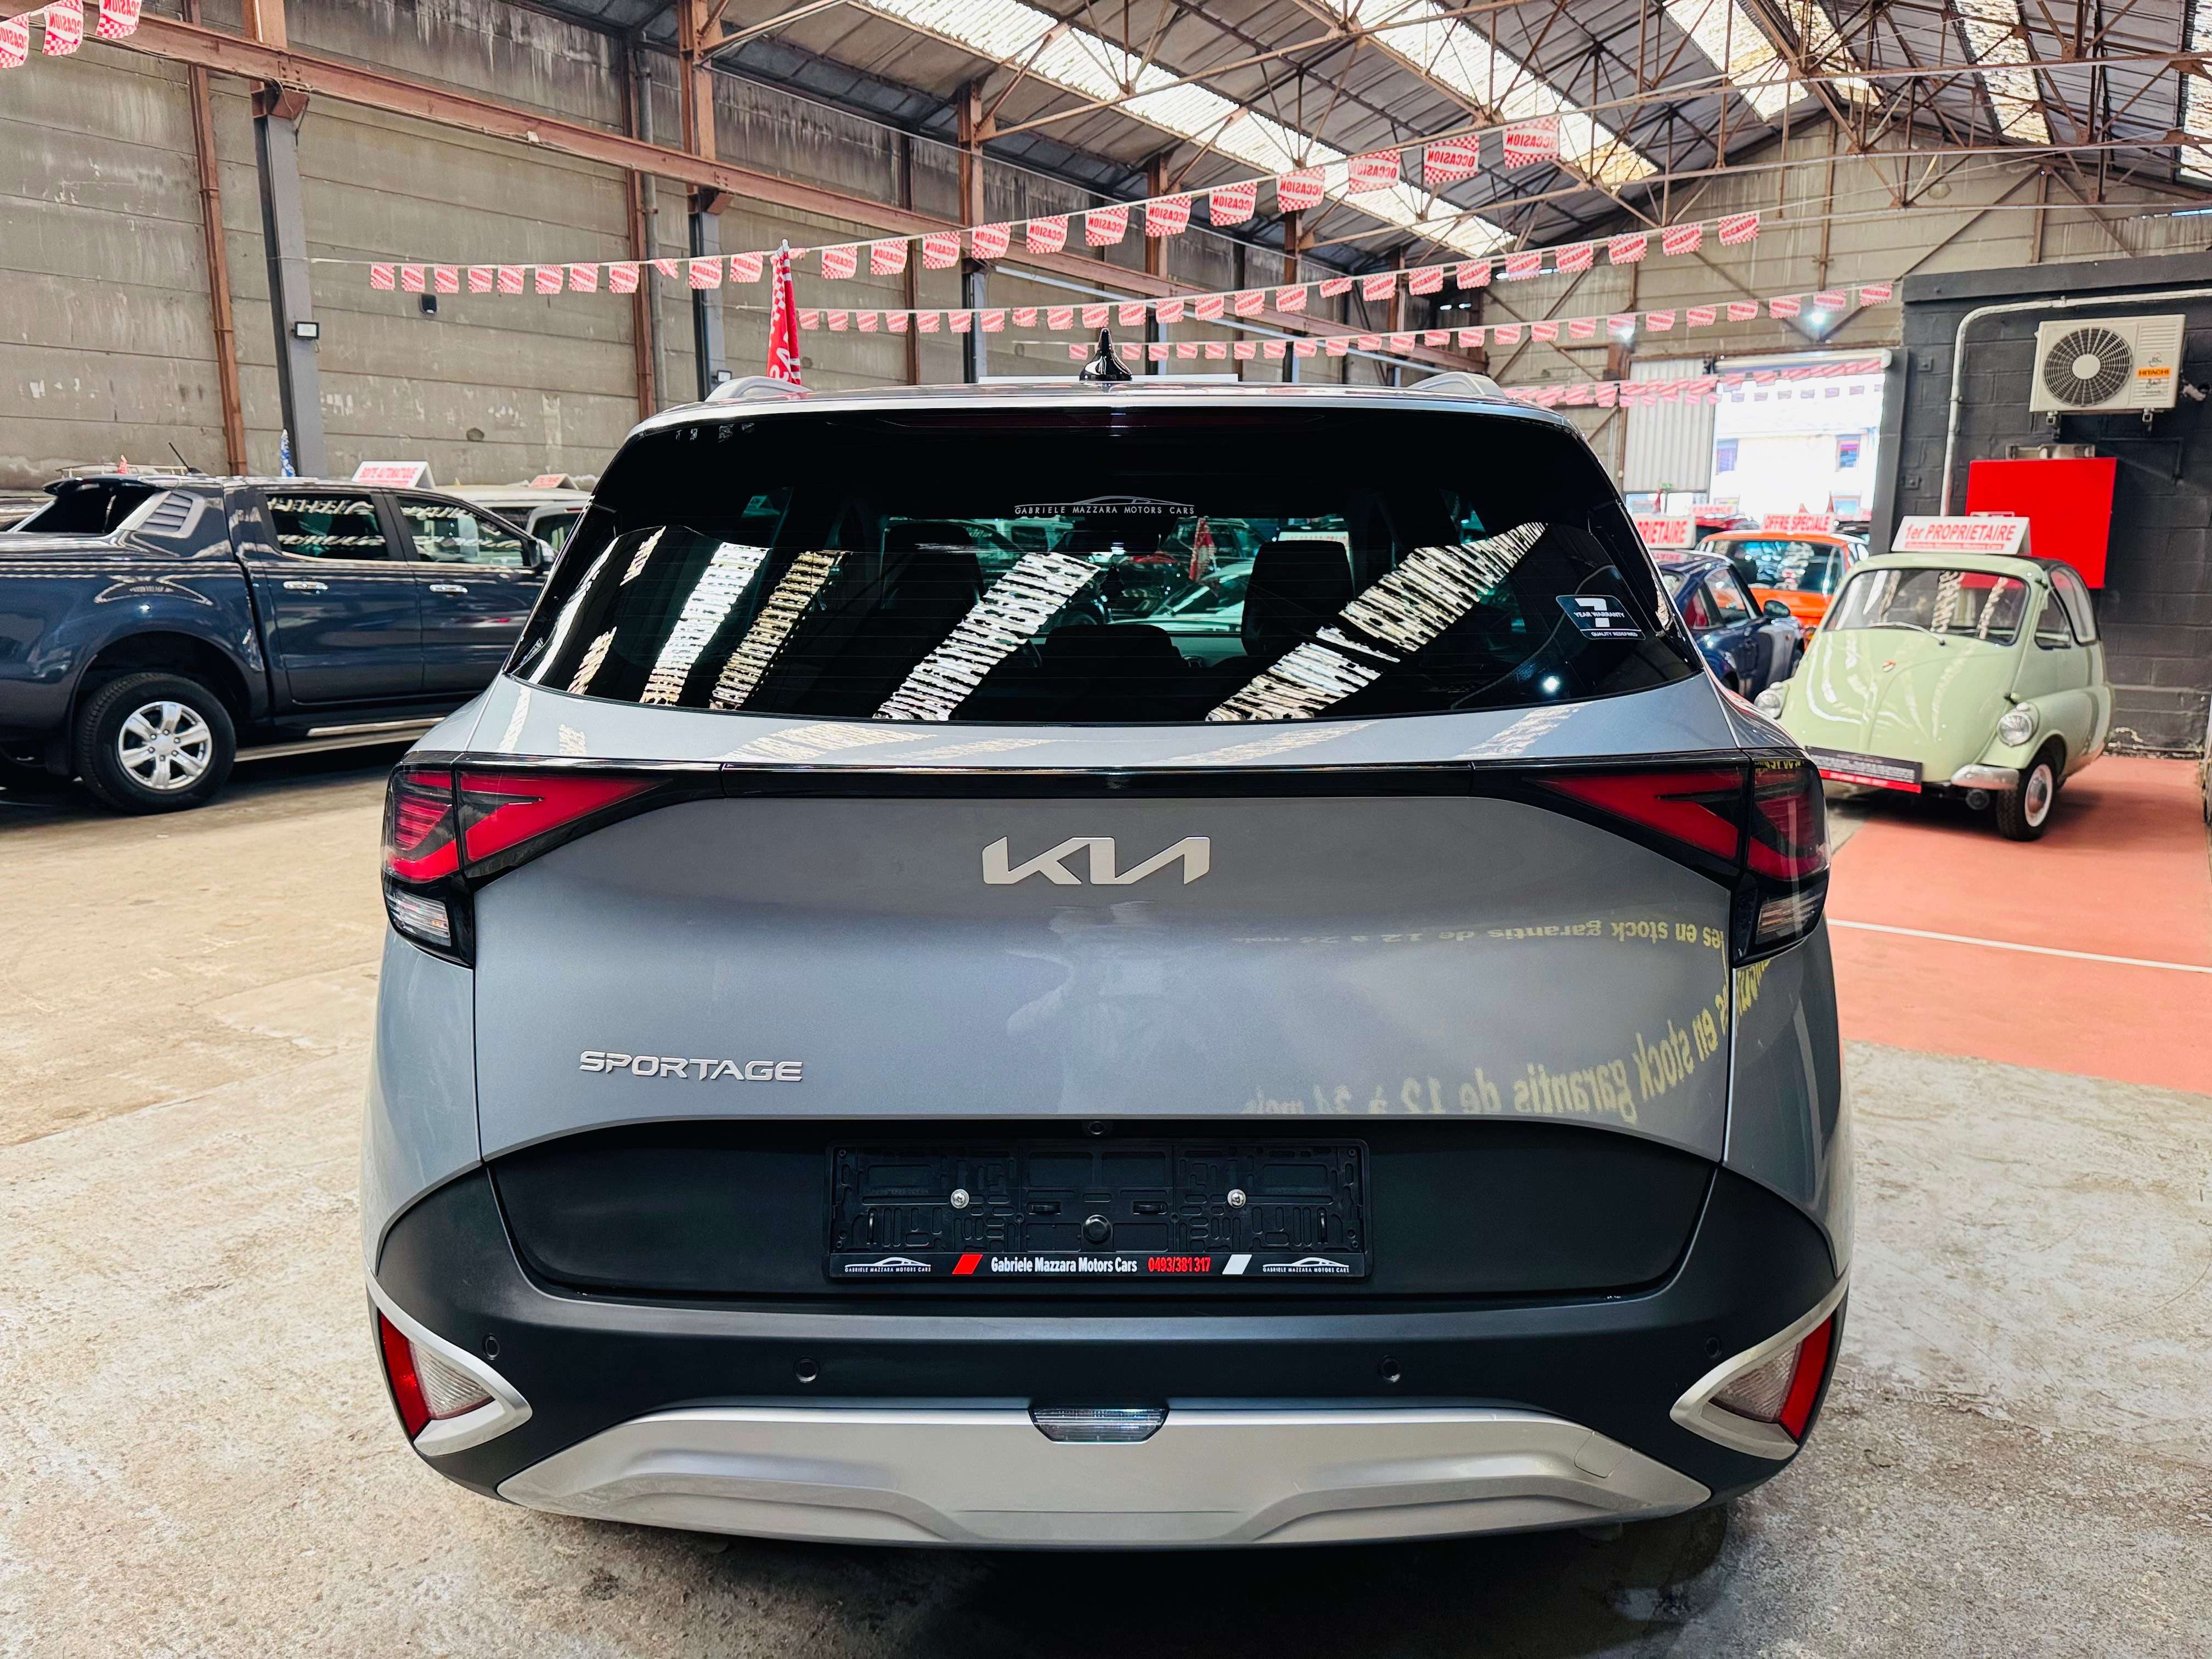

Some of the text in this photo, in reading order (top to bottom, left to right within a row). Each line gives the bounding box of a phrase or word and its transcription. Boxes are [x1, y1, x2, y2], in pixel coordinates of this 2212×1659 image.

[1905, 523, 2017, 541] 1er PROPRIETAIRE
[1487, 920, 1602, 940] garantis
[1611, 921, 1668, 944] stock
[1675, 923, 1697, 943] en
[579, 1050, 803, 1082] SPORTAGE
[991, 1257, 1032, 1273] Gabriele
[1035, 1257, 1077, 1272] Mazzara
[1079, 1257, 1114, 1272] Motors
[1115, 1257, 1138, 1273] Cars
